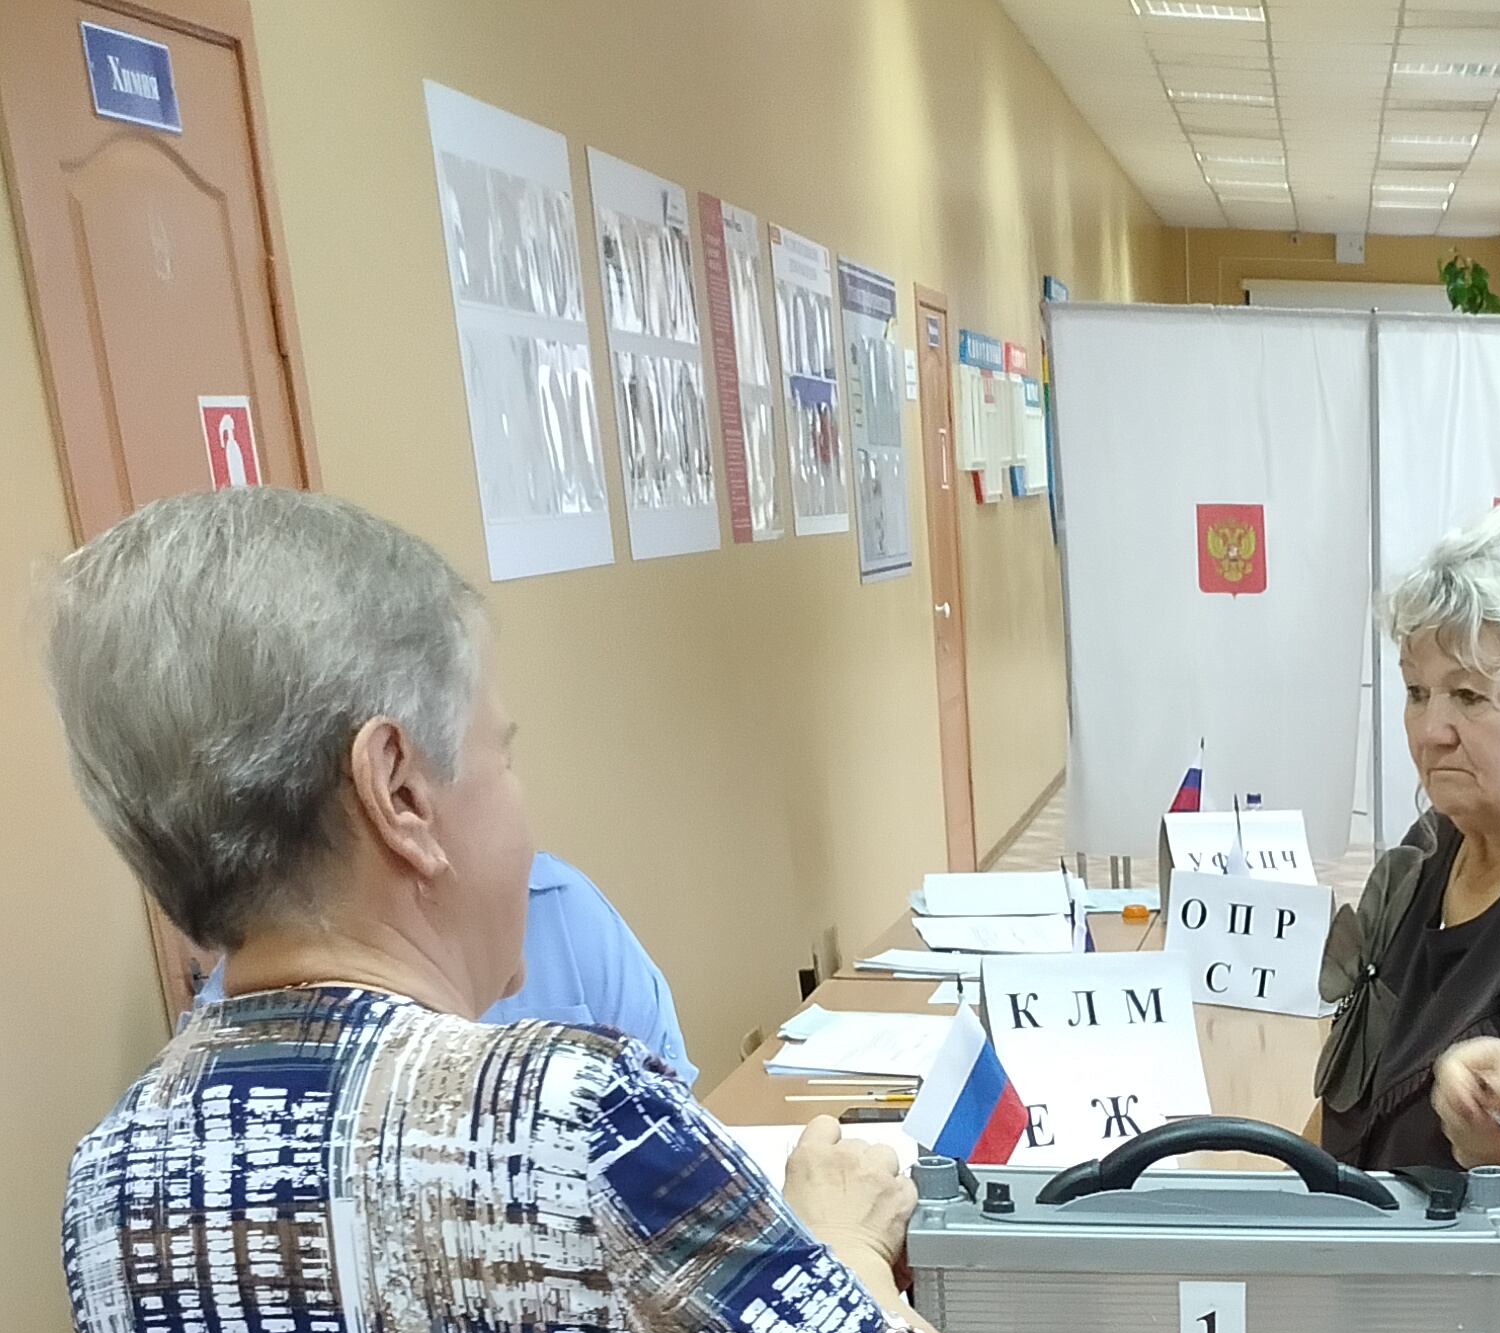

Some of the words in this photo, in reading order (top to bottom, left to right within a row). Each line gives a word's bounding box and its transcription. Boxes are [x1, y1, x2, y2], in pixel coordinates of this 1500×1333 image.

[107, 54, 160, 101] Химия
[1181, 898, 1207, 930] О
[1227, 902, 1255, 936] П
[1273, 907, 1297, 940] Р
[1206, 961, 1232, 993] С
[1251, 966, 1276, 999] Т
[1004, 992, 1044, 1030] К
[1067, 989, 1101, 1027] Л
[1121, 987, 1167, 1024] М
[1090, 1094, 1143, 1140] Ж
